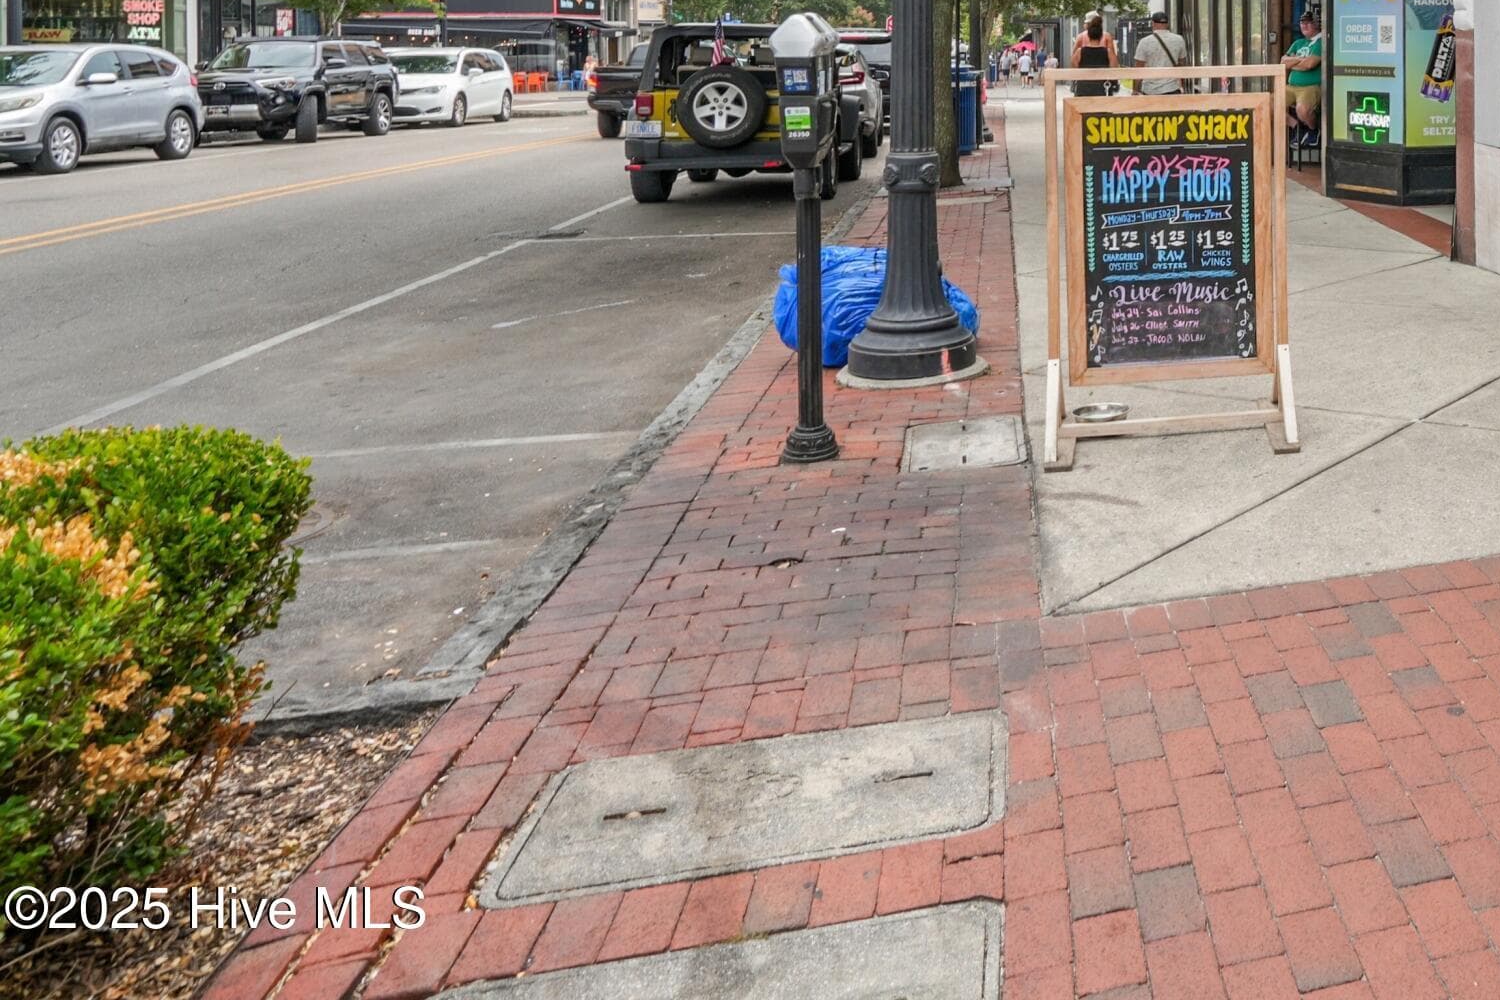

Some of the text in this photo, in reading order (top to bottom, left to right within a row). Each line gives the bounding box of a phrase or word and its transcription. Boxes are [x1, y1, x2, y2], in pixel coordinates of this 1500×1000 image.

[122, 0, 164, 12] SMOKE
[127, 12, 160, 25] SHOP
[127, 26, 161, 41] ATM
[1346, 23, 1372, 33] ORDER
[27, 30, 62, 40] RAW
[1345, 34, 1374, 44] ONLINE
[1429, 115, 1450, 124] TRY
[1101, 168, 1231, 204] HAPPY HOUR
[1102, 252, 1145, 263] CHARGRILLED
[1157, 249, 1185, 262] RAW
[1108, 262, 1139, 271] OYSTERS
[1152, 262, 1188, 270] OYSTERS
[1200, 257, 1232, 267] WINGS
[1108, 281, 1235, 306] Live Music
[1167, 304, 1200, 315] Collins
